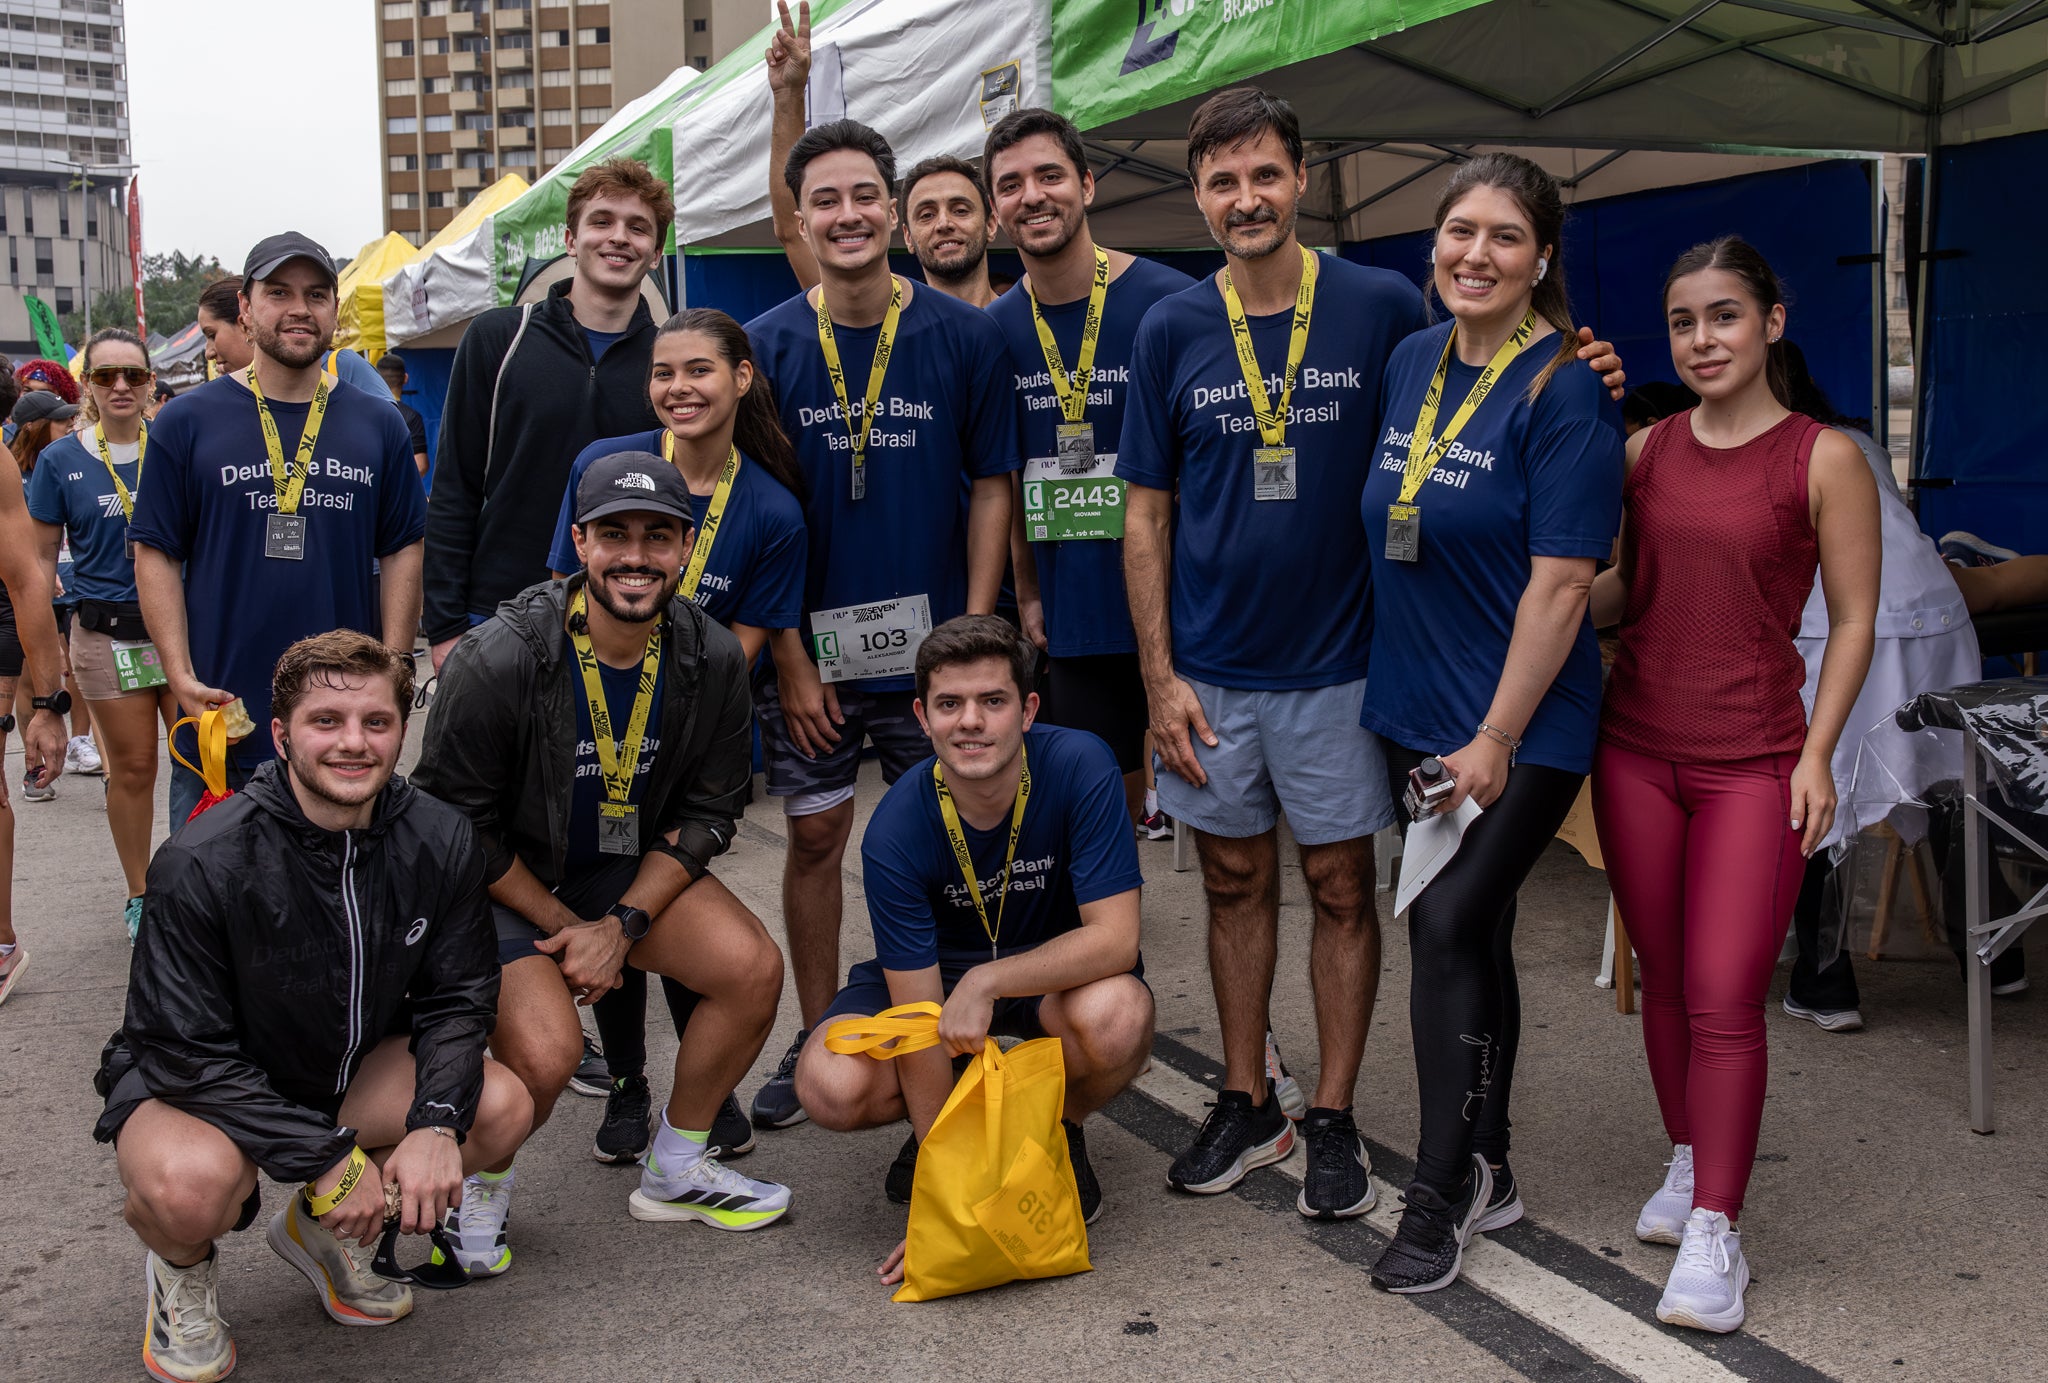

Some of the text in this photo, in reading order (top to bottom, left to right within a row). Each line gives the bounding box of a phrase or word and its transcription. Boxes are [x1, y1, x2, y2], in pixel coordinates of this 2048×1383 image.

[1094, 258, 1108, 289] 14K
[891, 288, 901, 308] 7K
[1231, 314, 1248, 337] 7K
[1294, 311, 1309, 332] 7K
[1509, 326, 1531, 348] 7K
[828, 363, 843, 386] 7K
[1075, 367, 1090, 395] 14K
[1303, 366, 1361, 389] Bank
[1476, 366, 1495, 395] SEVEN
[865, 400, 877, 419] 7K
[889, 396, 934, 420] Bank
[1284, 400, 1340, 426] Brasil
[98, 437, 107, 453] 14K
[300, 434, 316, 453] 7K
[870, 428, 916, 447] Brasil
[1430, 435, 1453, 457] 7K
[1446, 441, 1496, 471] Bank
[68, 471, 83, 481] nu
[326, 457, 375, 487] Bank
[614, 477, 642, 485] NORTH
[1069, 467, 1088, 475] RUN
[1261, 464, 1289, 483] 7K
[1427, 466, 1471, 490] rasil
[245, 487, 354, 511] Tea Brasil
[1029, 485, 1038, 507] C
[1053, 484, 1121, 509] 2443
[703, 511, 720, 532] 7K
[1026, 512, 1045, 522] 14K
[700, 572, 732, 592] ank
[864, 612, 884, 623] RUN
[867, 602, 896, 615] SEVEN
[646, 636, 660, 661] 7K
[822, 636, 833, 656] C
[860, 629, 908, 653] 103
[578, 647, 597, 673] 7K
[823, 659, 837, 668] 7K
[867, 650, 906, 661] ALEKSANDRO
[120, 669, 135, 678] 14K
[590, 700, 601, 730] SEVEN
[604, 770, 620, 791] 7K
[936, 777, 950, 801] 7K
[606, 820, 631, 838] 7K
[1009, 824, 1020, 846] 7K
[339, 1168, 351, 1189] RUN
[331, 1178, 356, 1206] SEVEN
